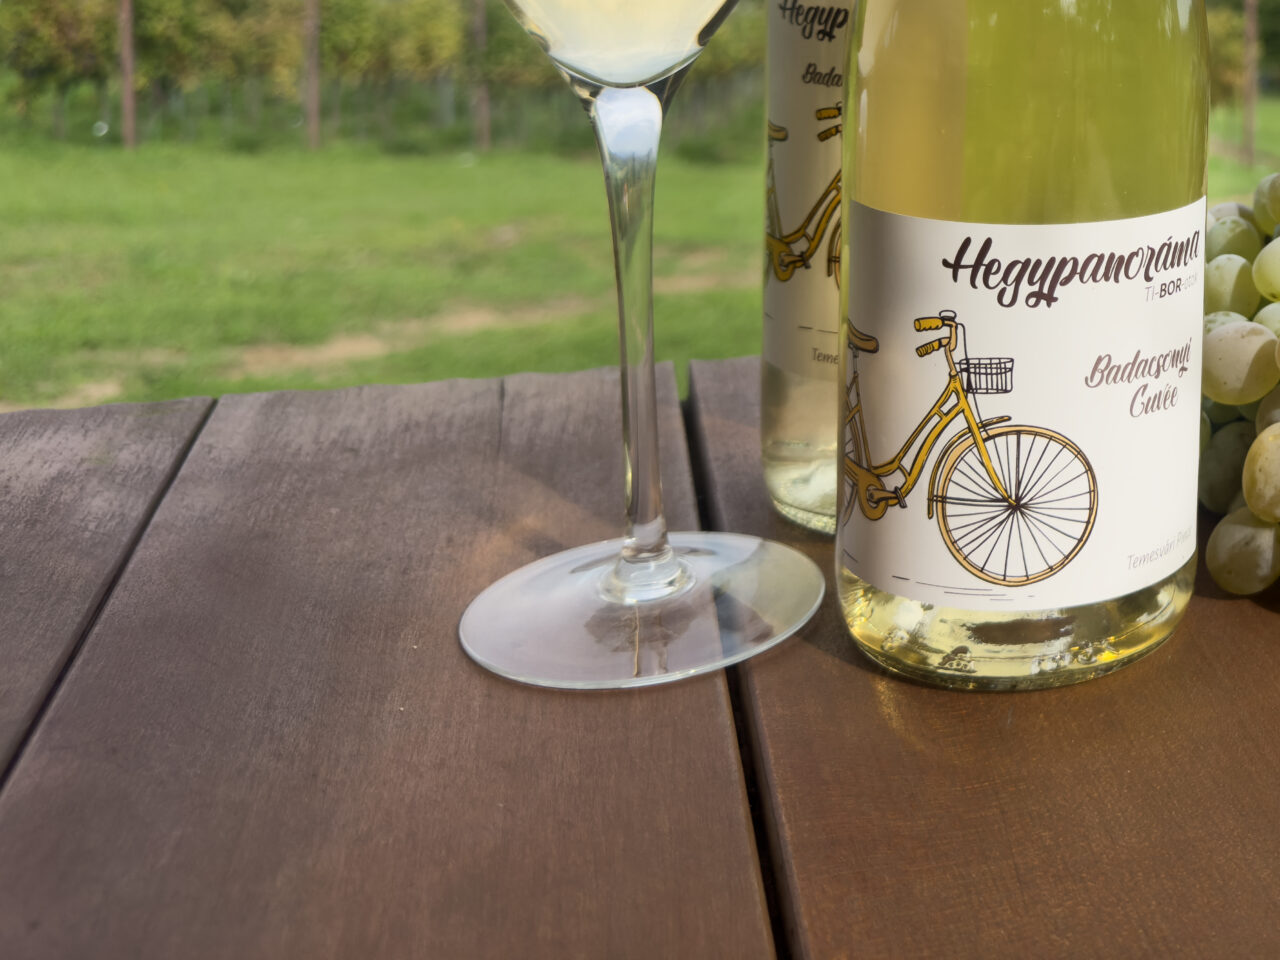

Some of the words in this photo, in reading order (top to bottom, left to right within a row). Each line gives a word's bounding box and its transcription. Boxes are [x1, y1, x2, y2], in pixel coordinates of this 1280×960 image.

[942, 229, 1200, 308] Hegypanoráma
[1084, 336, 1192, 388] Badacsonyi
[1129, 383, 1178, 418] Cuvée
